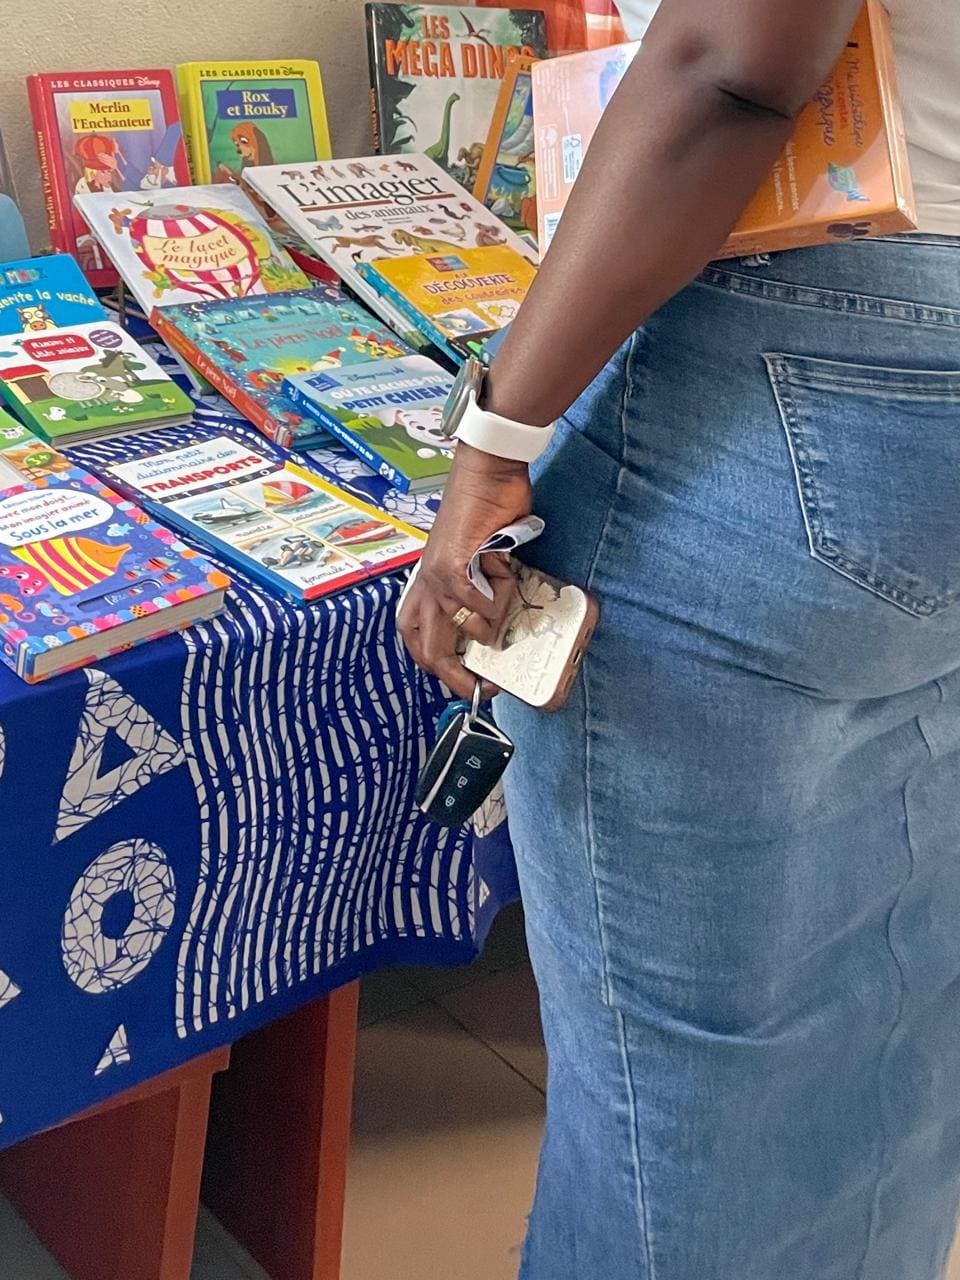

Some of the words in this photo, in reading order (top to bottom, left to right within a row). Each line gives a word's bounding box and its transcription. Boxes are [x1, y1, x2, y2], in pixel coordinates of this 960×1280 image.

[422, 15, 450, 39] LES
[385, 39, 455, 78] MEGA
[460, 43, 537, 80] DIN
[221, 68, 281, 77] CLASSIQUES
[50, 80, 71, 89] LES
[73, 78, 135, 88] CLASSIQUES
[134, 76, 161, 88] Disney
[242, 91, 270, 103] Rox
[90, 102, 131, 114] Merlin
[227, 105, 241, 117] et
[243, 103, 288, 119] Rouky
[73, 117, 152, 131] l'Enchanteur
[278, 174, 450, 206] L'imagier
[345, 207, 369, 221] des
[374, 202, 436, 218] animaux
[153, 238, 182, 256] Le
[189, 234, 230, 254] lacet
[162, 247, 237, 269] magique
[423, 274, 516, 294] DÉCOUVERTE
[35, 288, 52, 301] la
[56, 291, 97, 307] vache
[342, 396, 387, 410] PETIT
[385, 385, 448, 405] CHIEN
[139, 455, 174, 469] Mon
[141, 455, 263, 494] TRANSPORTS
[9, 523, 49, 541] Sous
[48, 519, 68, 530] la
[68, 508, 100, 523] mer
